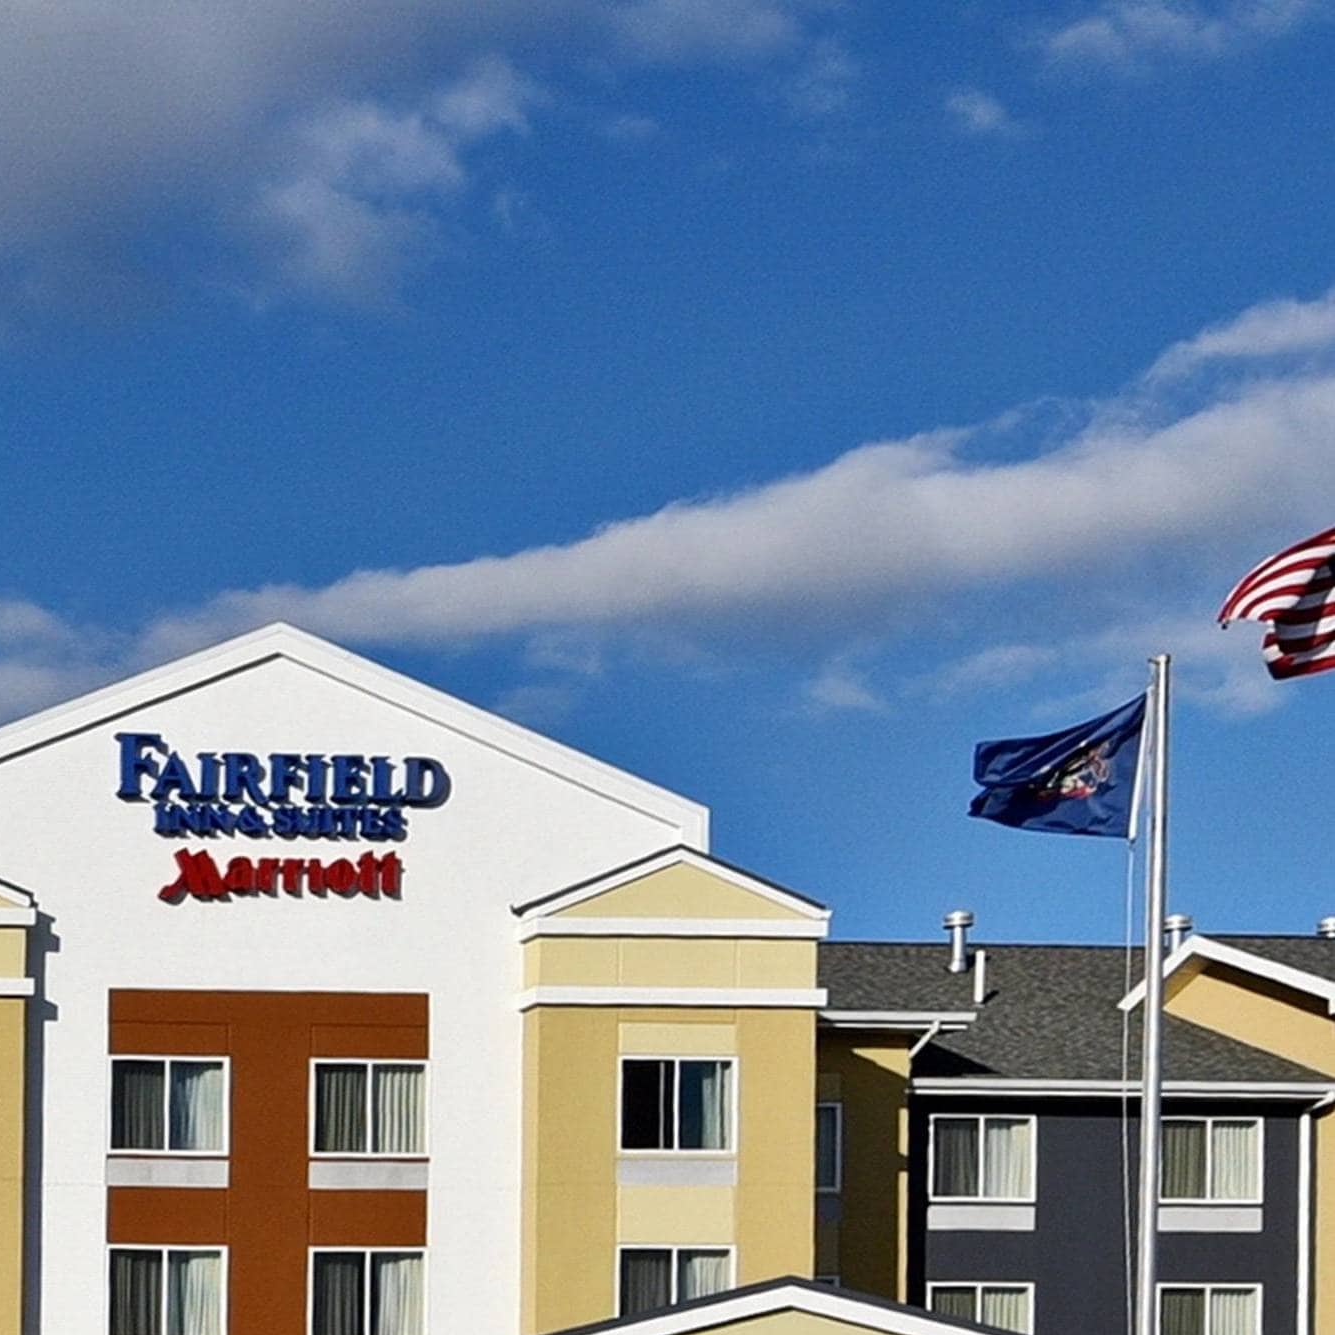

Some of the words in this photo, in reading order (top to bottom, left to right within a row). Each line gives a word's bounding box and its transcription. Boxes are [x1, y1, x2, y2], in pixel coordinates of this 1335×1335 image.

[115, 732, 450, 808] FAIRFIELD
[154, 802, 234, 838] INN
[271, 807, 408, 841] SUITES
[158, 848, 405, 904] Marriott
